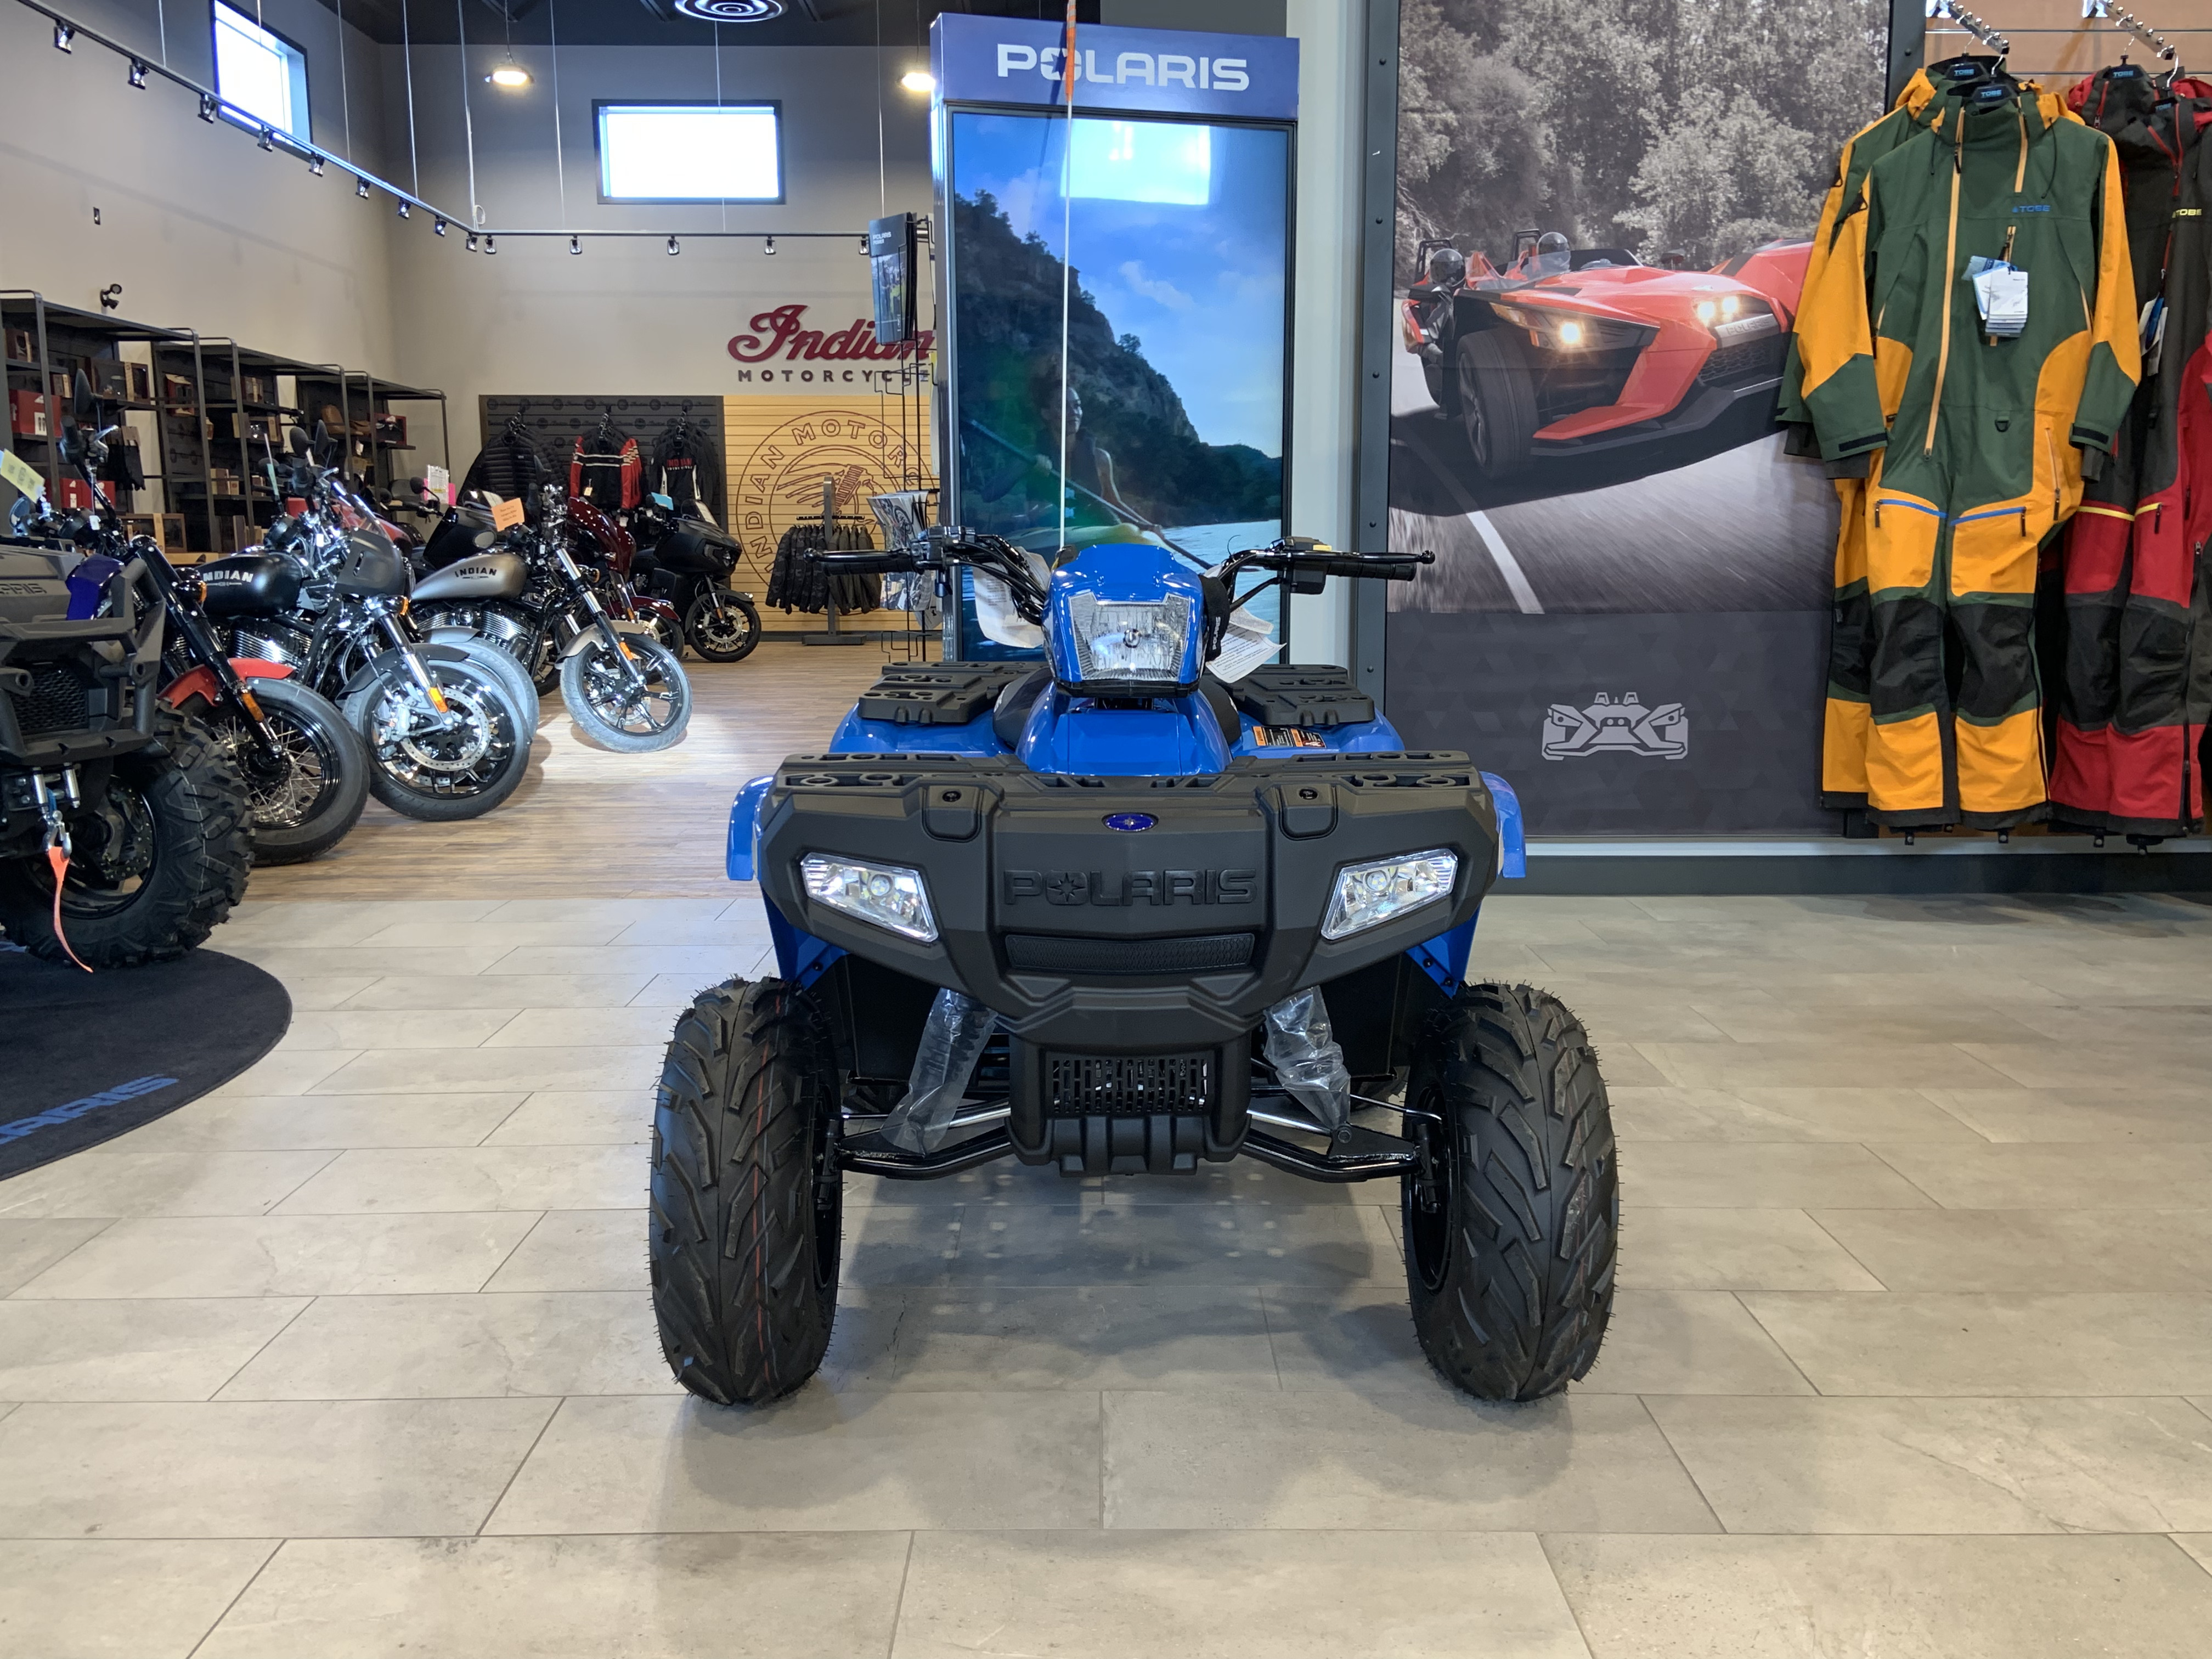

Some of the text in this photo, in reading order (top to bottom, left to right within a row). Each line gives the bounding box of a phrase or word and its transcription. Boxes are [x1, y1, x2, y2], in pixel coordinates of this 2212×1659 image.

[997, 43, 1249, 91] POLARIS
[727, 304, 935, 363] Indian
[202, 569, 253, 583] NDIAN
[454, 567, 497, 578] INDIAN
[1212, 616, 1221, 651] POLARIS
[1004, 868, 1257, 906] POLARIS
[0, 1074, 180, 1145] ARIS
